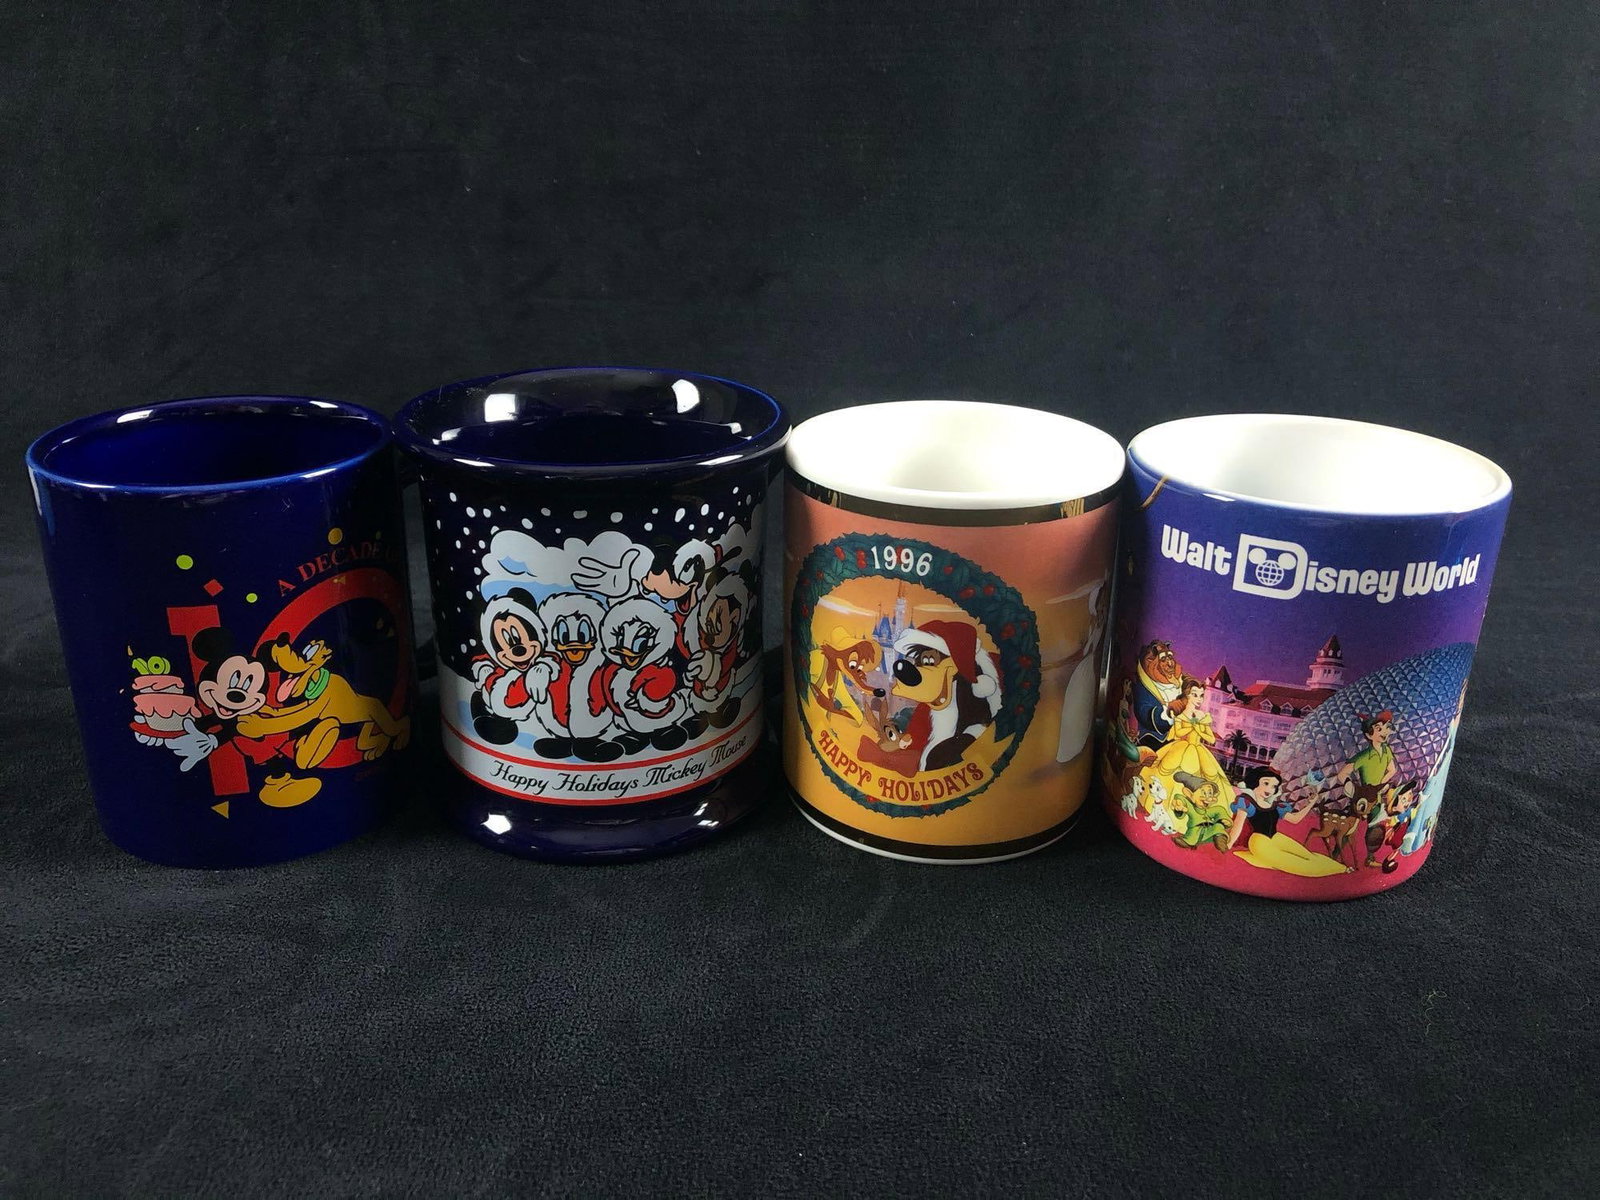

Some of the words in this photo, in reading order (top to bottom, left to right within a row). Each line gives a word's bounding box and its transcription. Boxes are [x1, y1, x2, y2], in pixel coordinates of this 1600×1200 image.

[277, 578, 296, 597] A
[297, 541, 382, 582] DECADE
[870, 545, 933, 577] 1996
[1161, 524, 1233, 576] Walt
[1233, 533, 1400, 603] Disney
[1401, 554, 1481, 597] World
[490, 761, 550, 795] Happy
[552, 772, 639, 798] Holidays
[642, 758, 706, 788] Mickey
[710, 736, 748, 764] Mouse
[818, 729, 872, 788] HAPPY
[879, 762, 984, 802] HOLIDAYS
